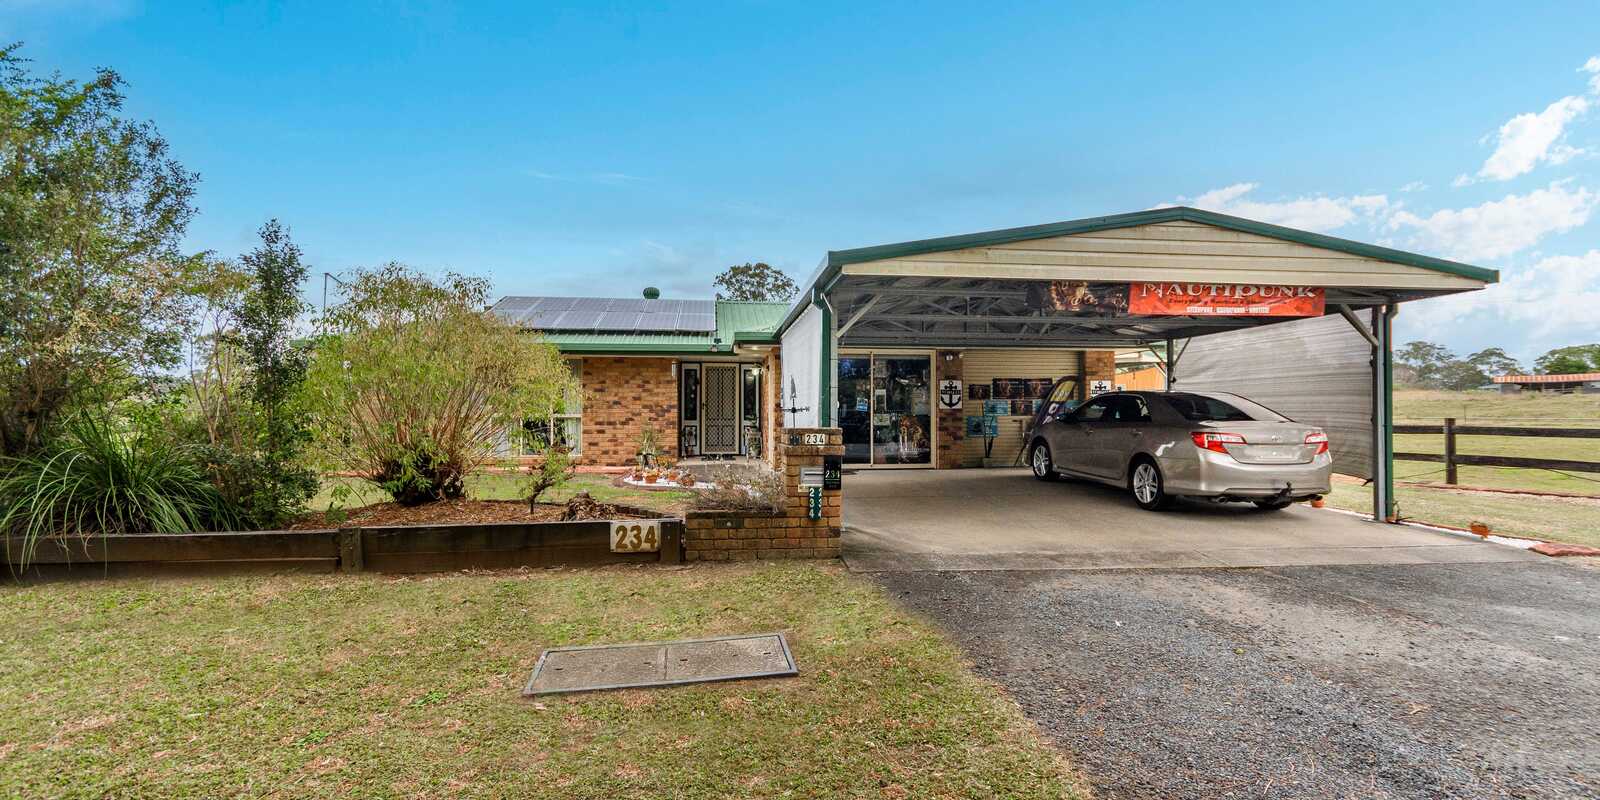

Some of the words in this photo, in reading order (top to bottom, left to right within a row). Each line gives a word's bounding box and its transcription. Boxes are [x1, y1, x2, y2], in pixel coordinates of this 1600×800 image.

[1141, 283, 1317, 299] NAUTIPUNK
[806, 434, 824, 444] 234
[825, 470, 840, 478] 234
[615, 524, 657, 549] 234
